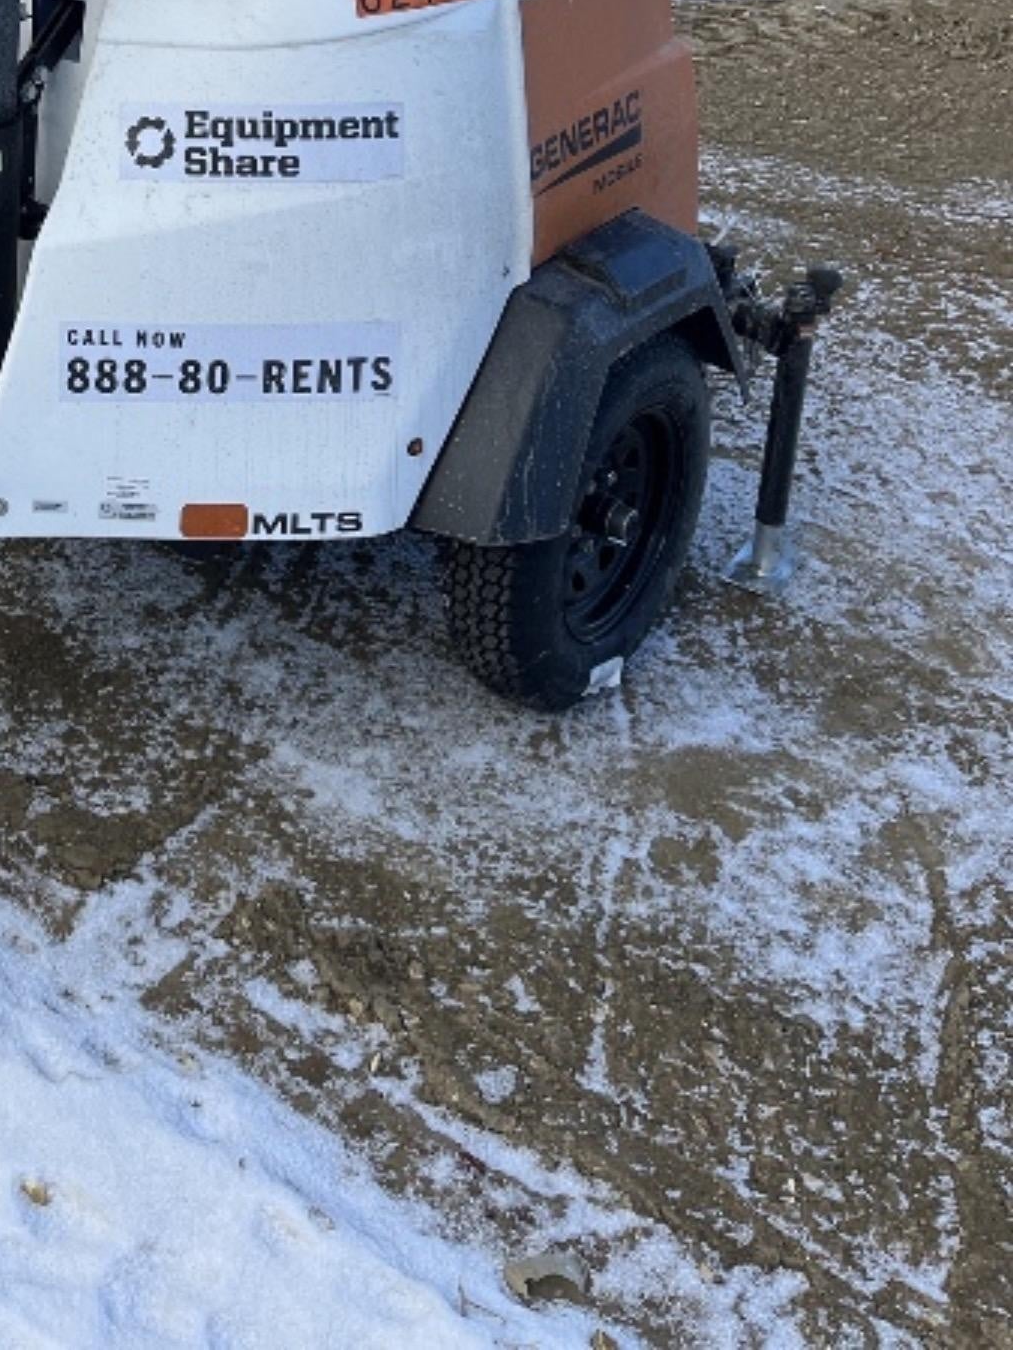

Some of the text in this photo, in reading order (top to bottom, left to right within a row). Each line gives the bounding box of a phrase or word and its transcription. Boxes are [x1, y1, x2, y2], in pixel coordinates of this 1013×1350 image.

[184, 110, 400, 148] Equipment
[530, 90, 643, 182] GENERAC
[184, 146, 300, 178] Share
[66, 329, 186, 348] CALL NOW
[66, 355, 394, 395] 888-80-RENTS
[252, 512, 363, 536] MLTS
